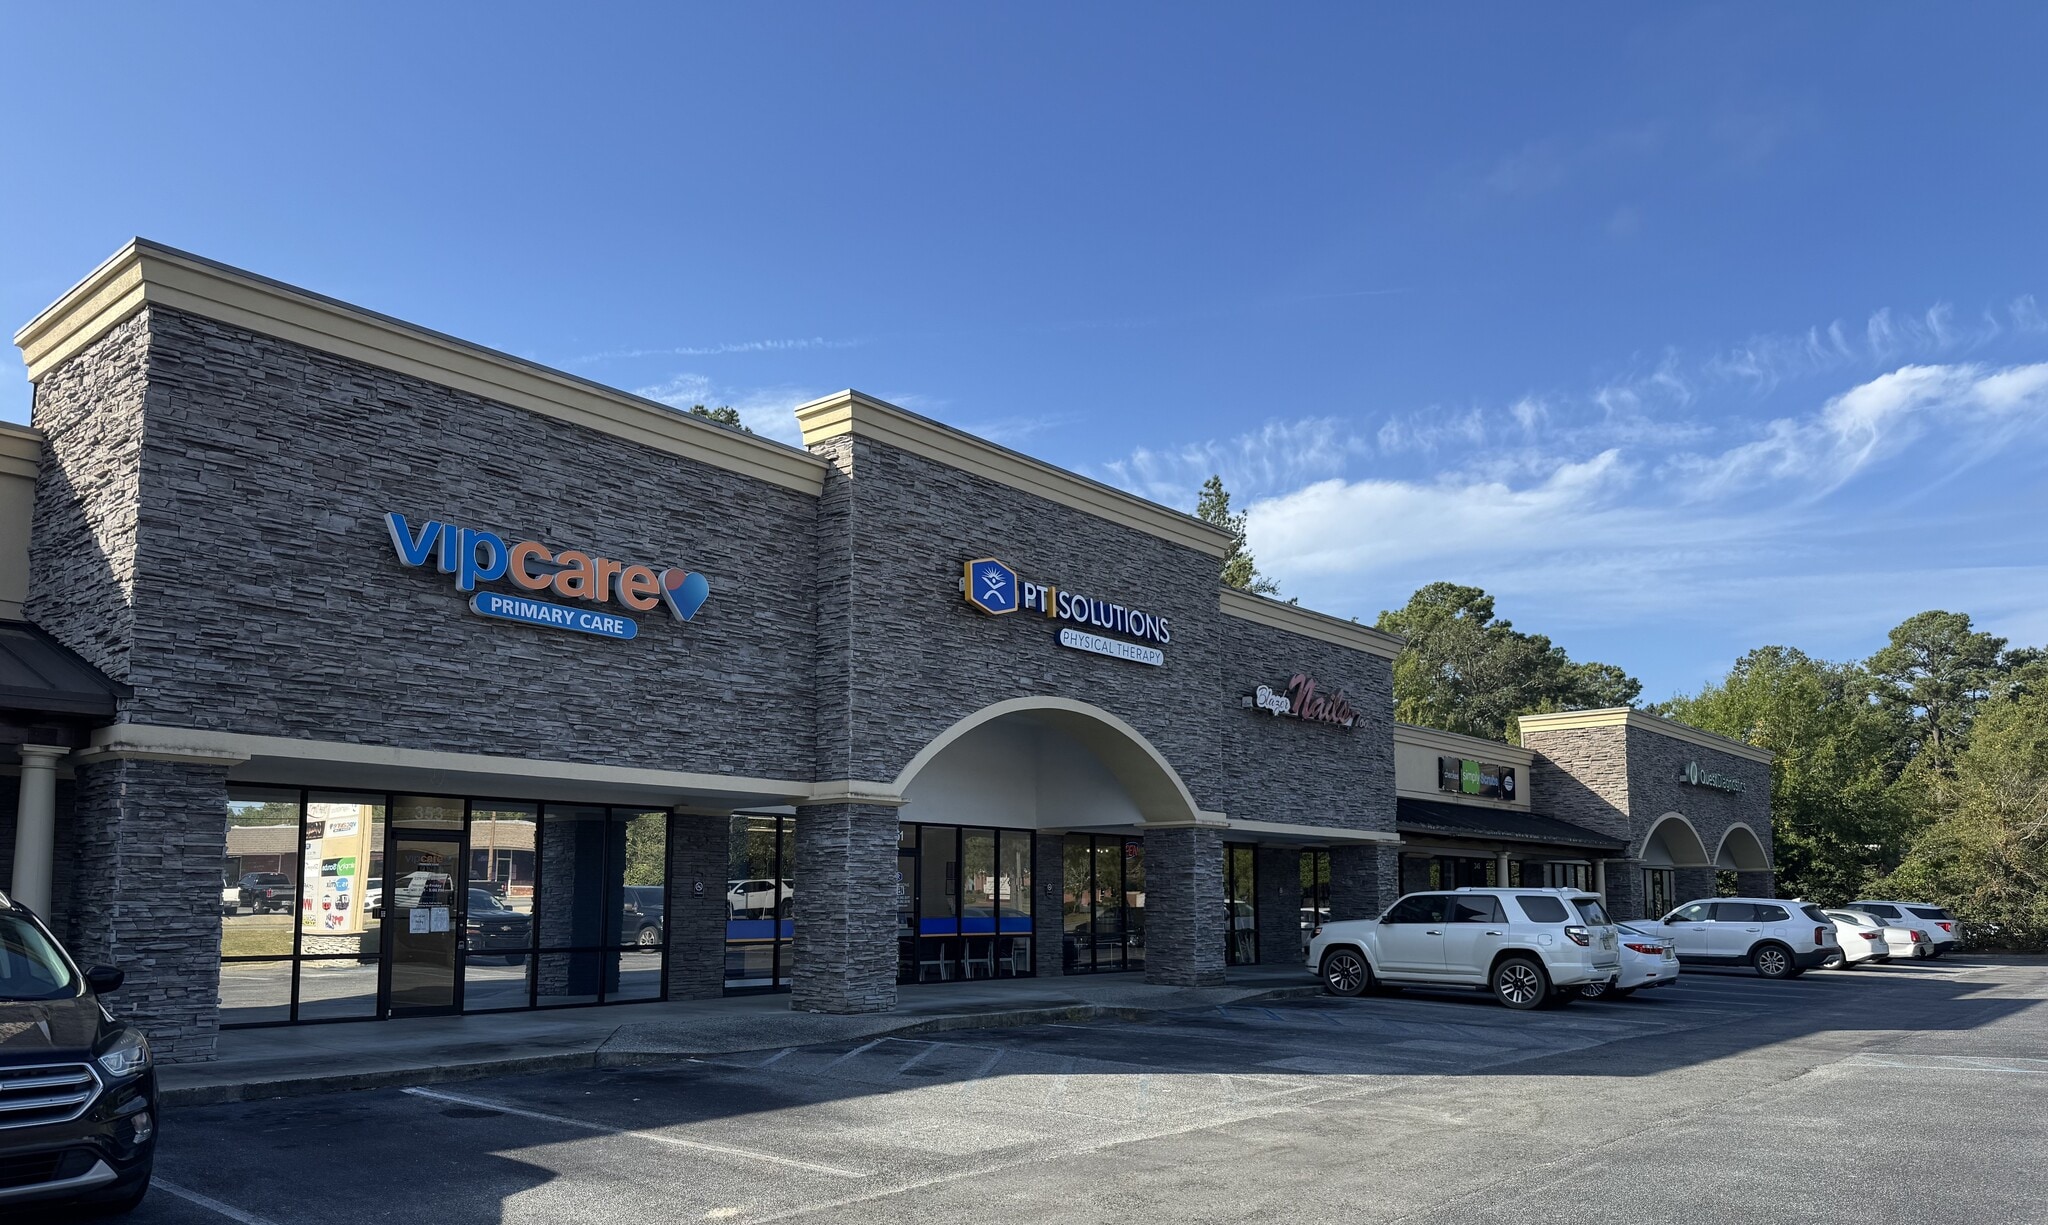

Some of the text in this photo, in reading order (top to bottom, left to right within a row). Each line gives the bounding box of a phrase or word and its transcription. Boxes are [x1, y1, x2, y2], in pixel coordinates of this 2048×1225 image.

[384, 512, 660, 612] vipcare
[490, 596, 625, 636] PRIMARY CARE
[1023, 581, 1171, 645] PT SOLUTIONS
[1062, 630, 1162, 665] PHYSICAL THERAPY
[1257, 686, 1290, 712] Blazer
[1288, 673, 1352, 724] Nails
[1462, 769, 1480, 785] simply
[414, 805, 444, 820] 353
[1125, 845, 1137, 856] PEN
